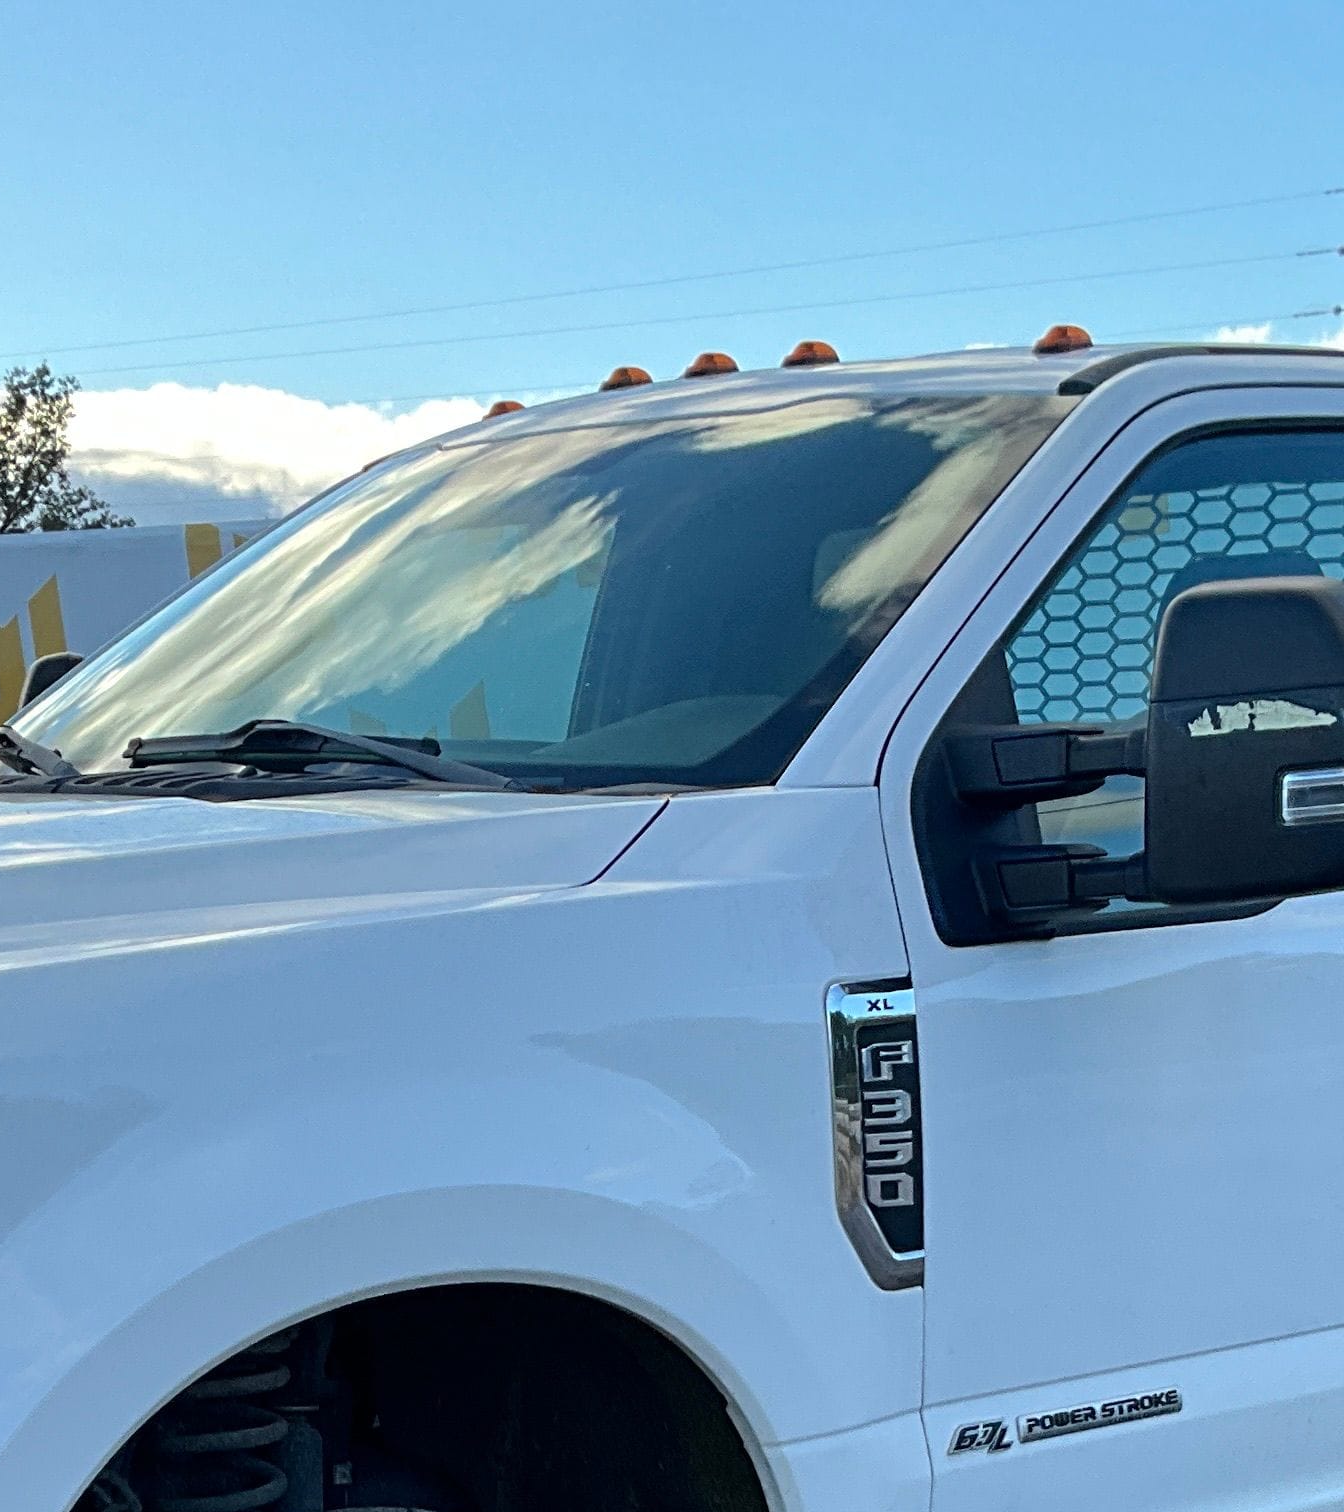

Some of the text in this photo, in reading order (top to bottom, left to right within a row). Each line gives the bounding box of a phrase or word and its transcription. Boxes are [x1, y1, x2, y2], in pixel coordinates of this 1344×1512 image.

[866, 998, 895, 1013] XL
[862, 1040, 914, 1208] F350
[1026, 1406, 1097, 1434] POWER
[1101, 1389, 1179, 1419] STROKE
